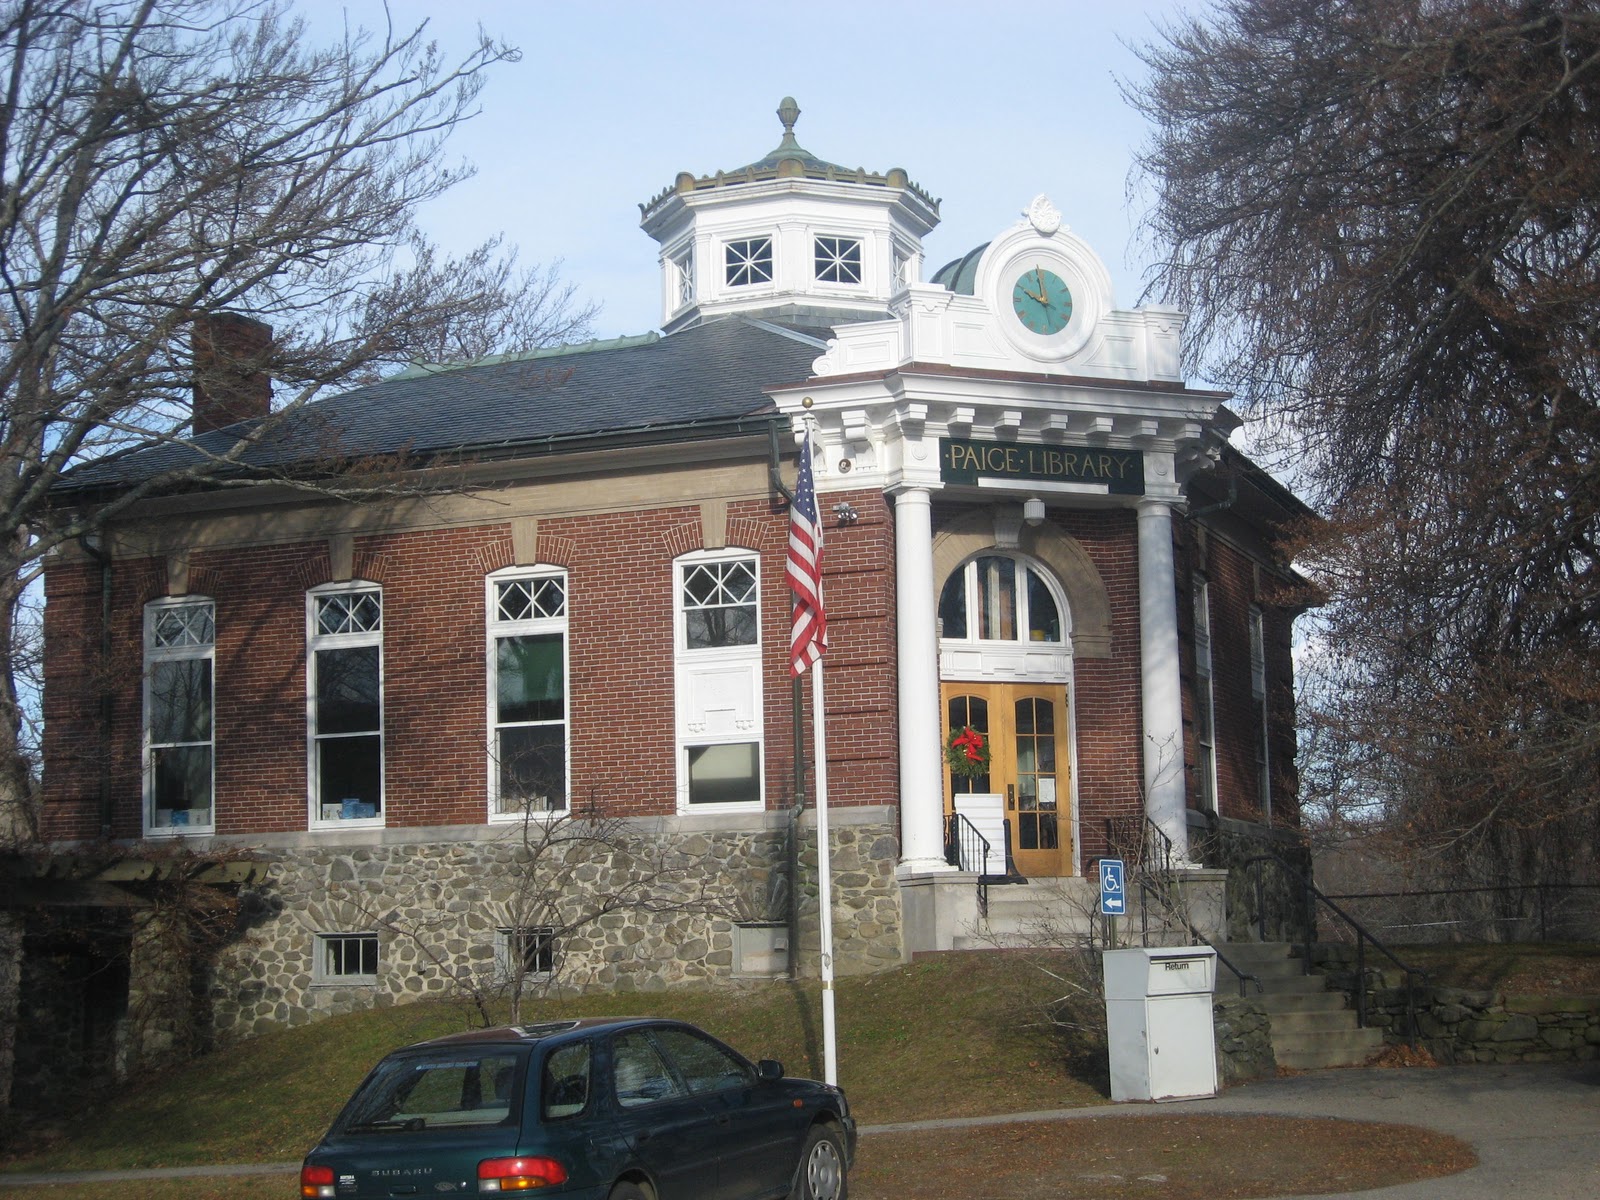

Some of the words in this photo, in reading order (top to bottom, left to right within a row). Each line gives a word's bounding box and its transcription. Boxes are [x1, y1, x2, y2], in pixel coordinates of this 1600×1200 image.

[950, 444, 1020, 473] PAIGE
[1029, 450, 1130, 479] LIBRARY
[1165, 962, 1189, 971] Return
[371, 1168, 433, 1177] SUBARU
